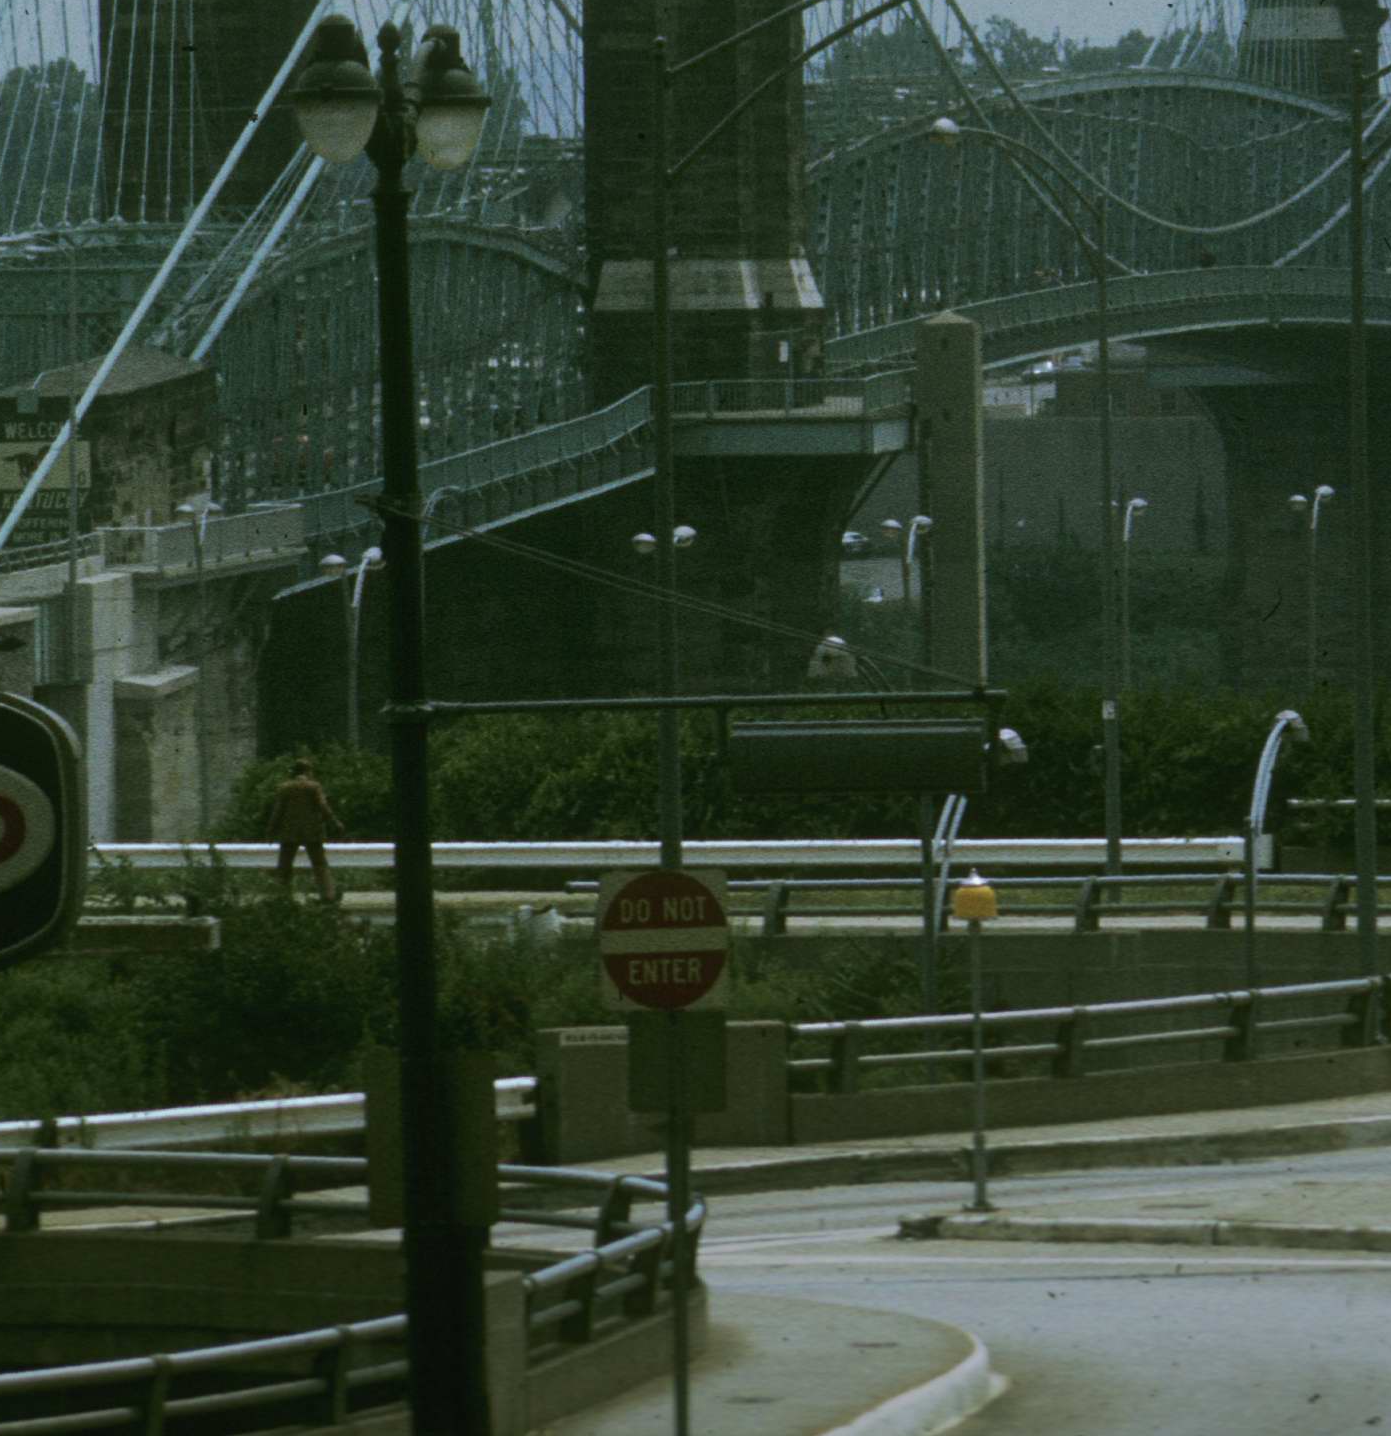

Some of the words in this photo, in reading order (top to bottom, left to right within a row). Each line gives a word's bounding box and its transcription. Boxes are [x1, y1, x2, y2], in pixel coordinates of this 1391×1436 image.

[4, 422, 82, 439] WELCOE
[620, 898, 649, 923] DO
[663, 896, 706, 921] NOT
[629, 958, 702, 985] ENTER
